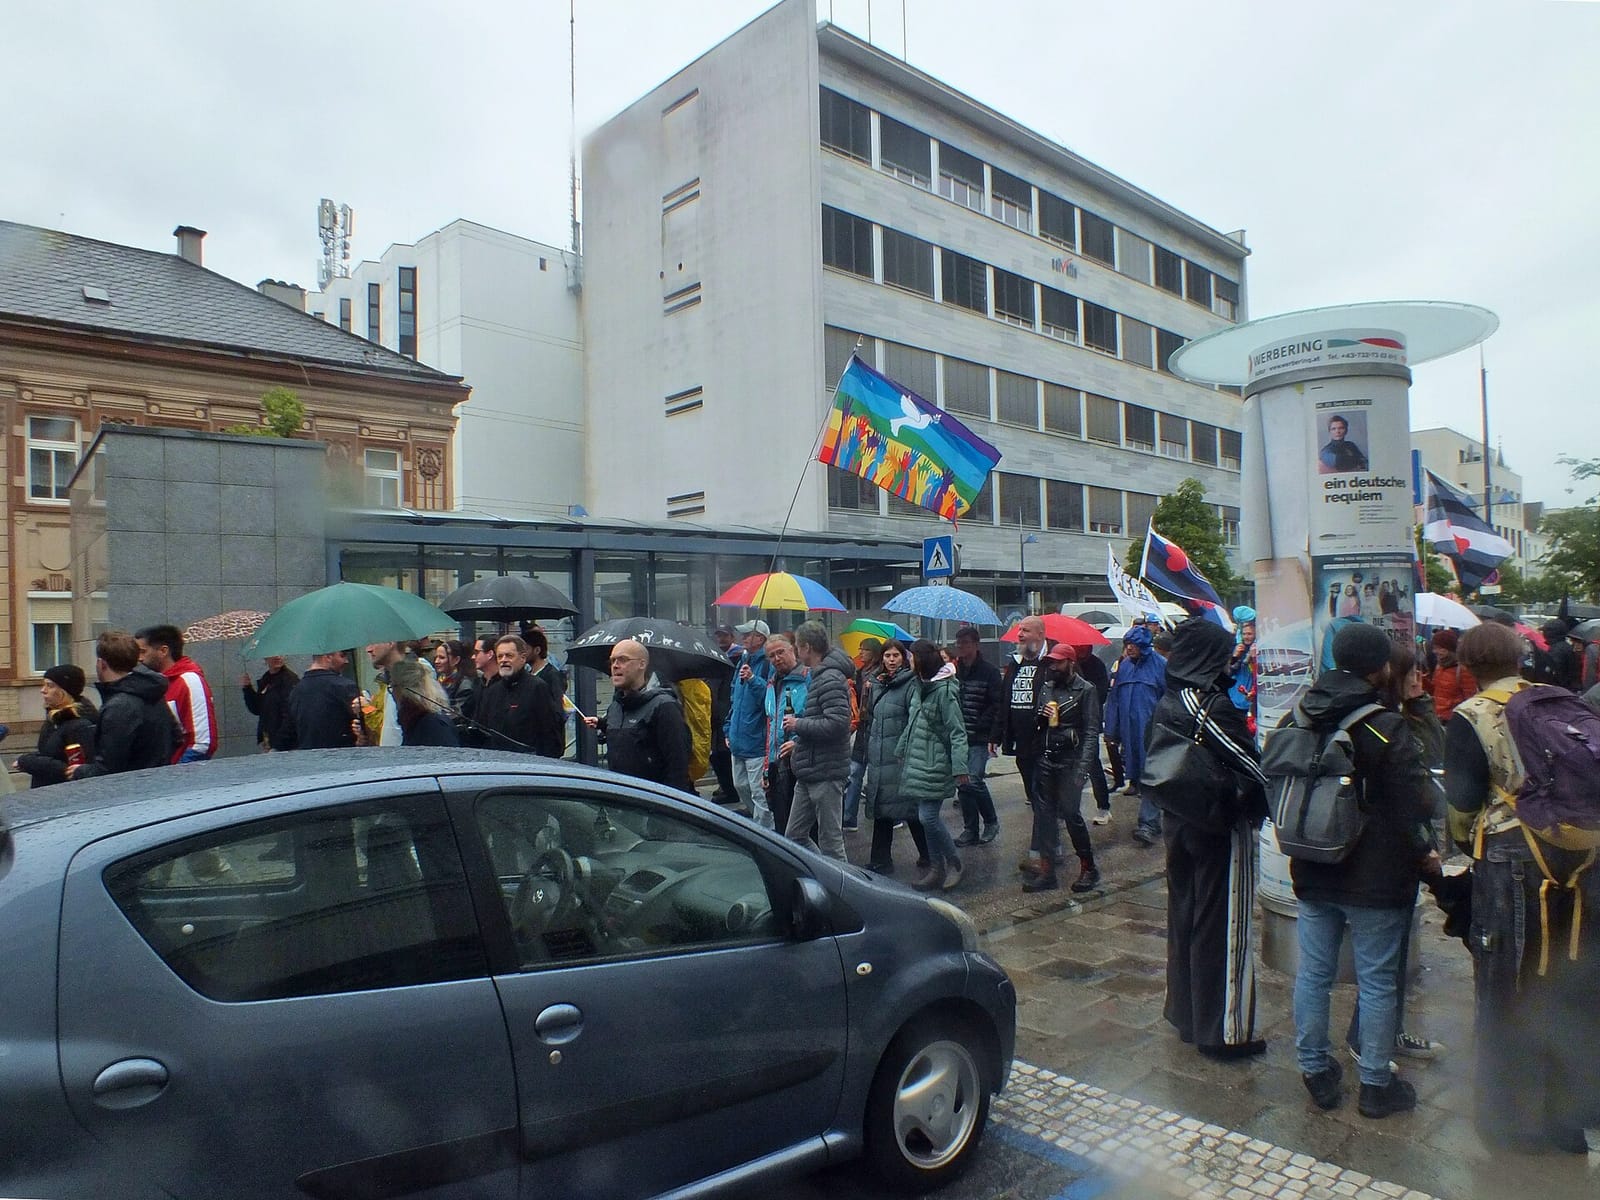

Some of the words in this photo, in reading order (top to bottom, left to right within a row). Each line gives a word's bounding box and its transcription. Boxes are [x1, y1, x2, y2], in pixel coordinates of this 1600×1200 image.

[1253, 339, 1323, 367] WERBERING
[1324, 477, 1347, 490] ein
[1349, 476, 1406, 489] deutsches
[1324, 490, 1383, 505] requiem
